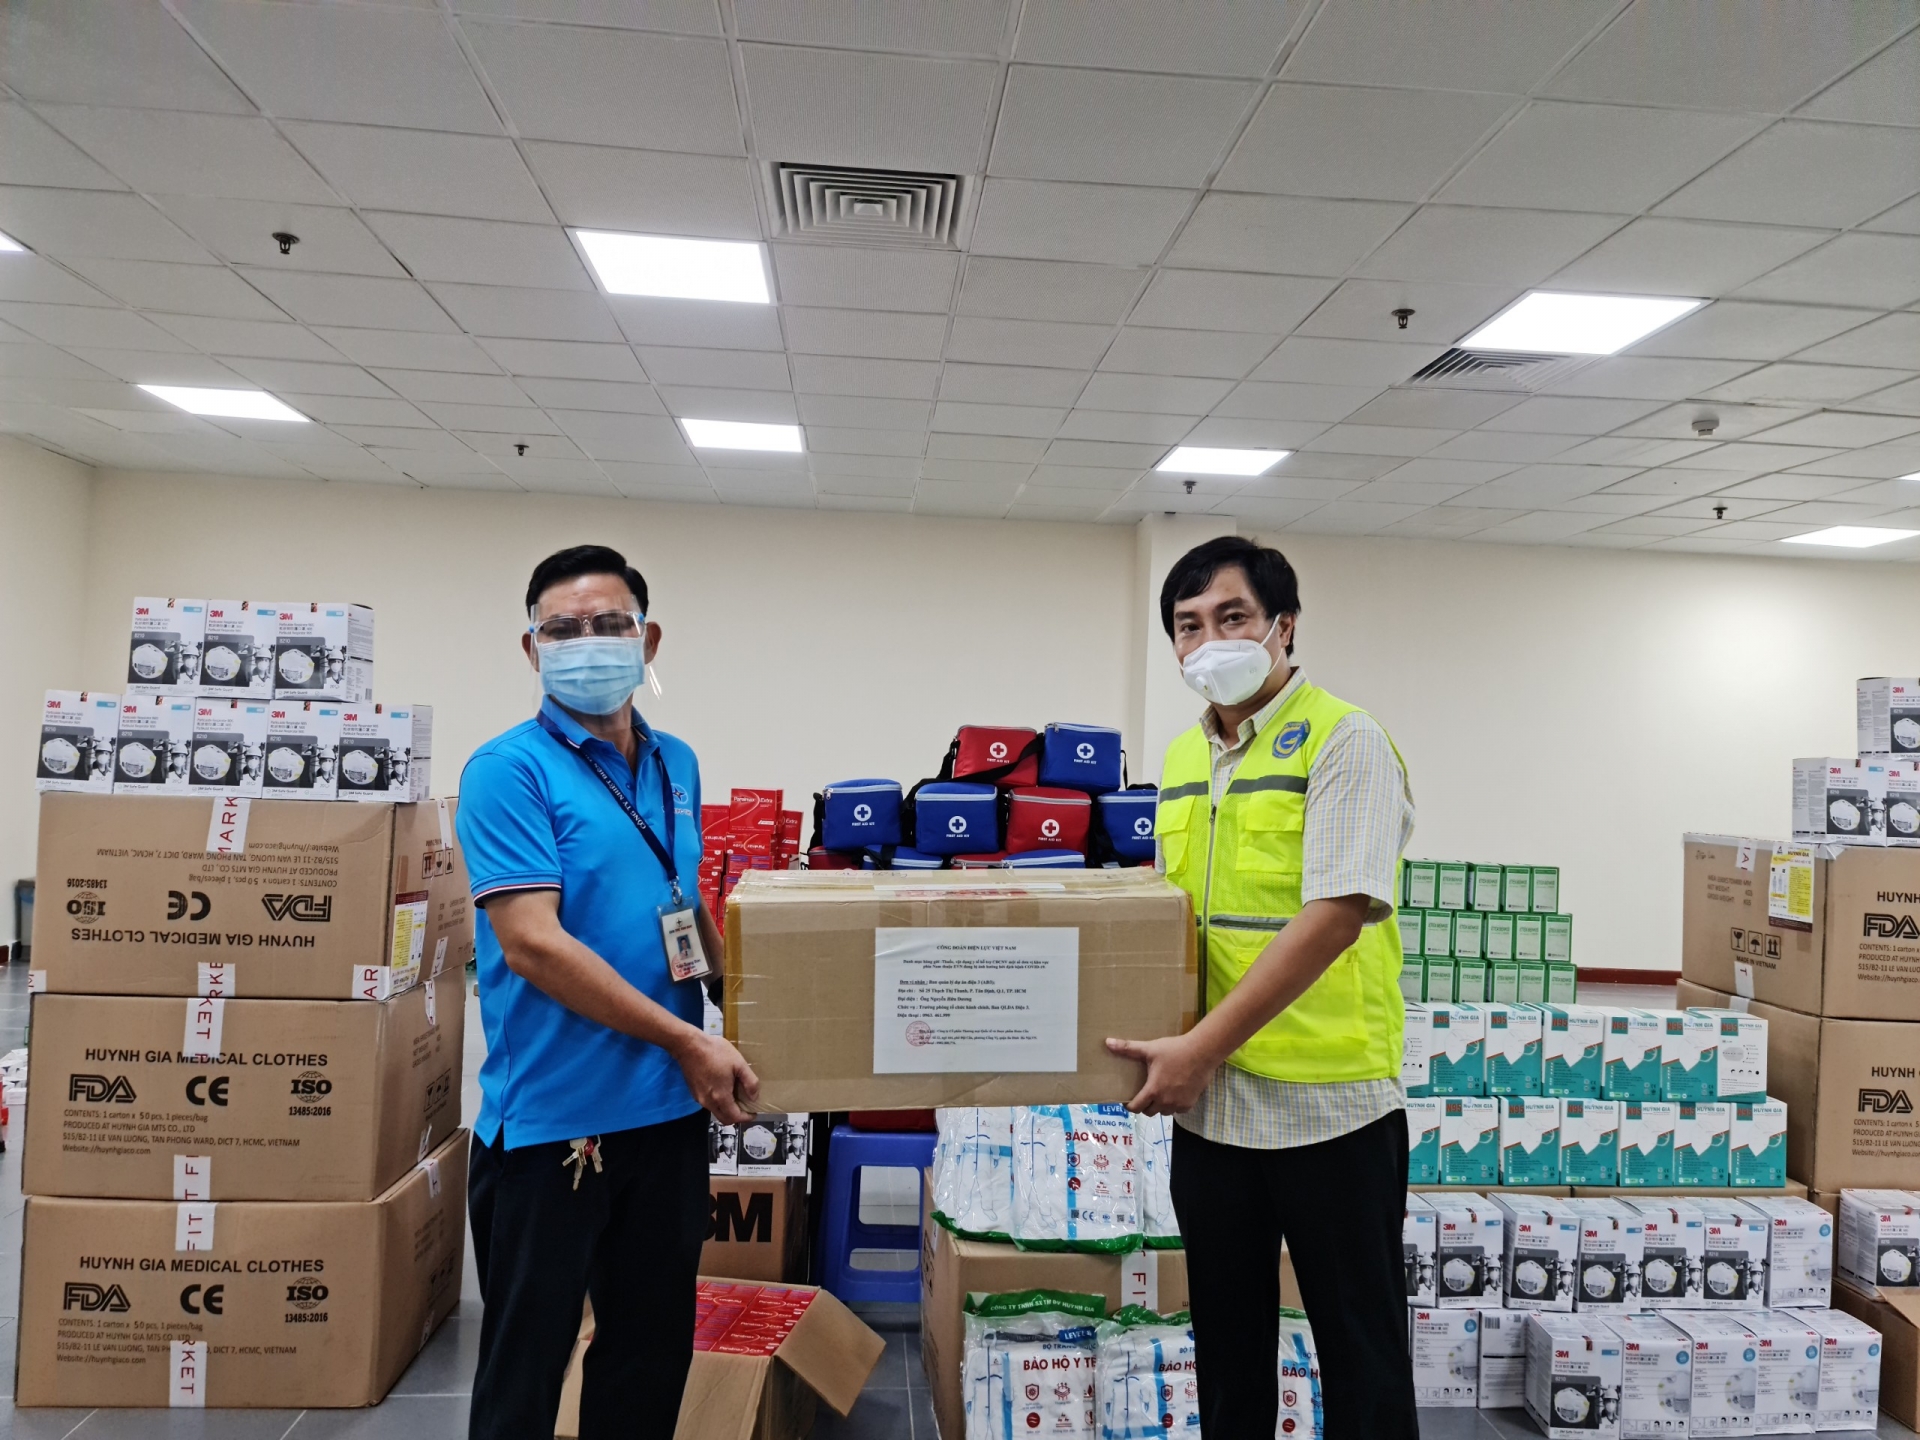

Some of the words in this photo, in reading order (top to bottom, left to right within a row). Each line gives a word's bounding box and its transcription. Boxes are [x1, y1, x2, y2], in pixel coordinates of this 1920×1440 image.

[47, 700, 61, 708] 3M
[123, 705, 137, 713] 3M
[198, 708, 212, 716] 3M
[271, 711, 285, 719] 3M
[343, 713, 358, 721] 3M
[1829, 767, 1841, 775] 3M
[202, 864, 214, 872] LTD
[230, 865, 246, 873] MTS
[247, 866, 261, 874] GIA
[262, 866, 288, 875] HUYNH
[289, 867, 299, 875] AT
[300, 868, 338, 876] PRODUCED
[67, 878, 108, 889] 13485:2016
[188, 874, 226, 884] pieces/bag
[270, 877, 291, 886] carton
[298, 878, 338, 888] CONTENTS:
[67, 899, 106, 916] ISO
[167, 890, 212, 921] CE
[261, 894, 332, 922] FDA
[1863, 913, 1920, 939] FDA
[71, 928, 145, 942] CLOTHES
[149, 931, 221, 945] MEDICAL
[226, 932, 253, 946] GIA
[259, 934, 315, 947] HUYNH
[1434, 1016, 1449, 1024] N95
[1492, 1016, 1507, 1024] N95
[1552, 1018, 1568, 1027] N95
[1667, 1022, 1683, 1031] N95
[85, 1048, 140, 1063] HUYNH
[145, 1050, 172, 1063] GIA
[177, 1052, 247, 1066] MEDICAL
[253, 1053, 328, 1066] CLOTHES
[1872, 1066, 1915, 1078] HUYNH
[69, 1074, 137, 1103] FDA
[186, 1076, 230, 1106] CE
[291, 1078, 332, 1097] ISO
[1858, 1088, 1913, 1113] FDA
[288, 1106, 331, 1116] 13485:2016
[1509, 1105, 1524, 1114] N95
[1627, 1107, 1642, 1115] N95
[171, 1113, 208, 1123] pieces/bag
[63, 1121, 100, 1130] PRODUCED
[101, 1122, 111, 1130] AT
[111, 1122, 136, 1131] HUYNH
[137, 1123, 150, 1131] GIA
[151, 1123, 166, 1132] MTS
[98, 1134, 107, 1142] LE
[108, 1134, 122, 1143] VAN
[123, 1135, 150, 1144] LUONG,
[151, 1135, 166, 1144] TAN
[166, 1136, 191, 1144] PHONG
[193, 1137, 216, 1146] WARD,
[217, 1137, 234, 1145] DICT
[243, 1138, 267, 1147] HCMC,
[268, 1138, 300, 1146] VIETNAM
[1111, 1135, 1119, 1144] Y
[1880, 1215, 1891, 1223] 3M
[1443, 1223, 1456, 1231] 3M
[1645, 1223, 1658, 1231] 3M
[1584, 1230, 1597, 1238] 3M
[80, 1256, 134, 1270] HUYNH
[140, 1258, 166, 1271] GIA
[170, 1259, 242, 1273] MEDICAL
[247, 1259, 324, 1273] CLOTHES
[63, 1282, 131, 1312] FDA
[286, 1285, 329, 1301] ISO
[180, 1284, 224, 1315] CE
[285, 1313, 328, 1323] 13485:2016
[1416, 1312, 1430, 1320] 3M
[1824, 1337, 1838, 1346] 3M
[1625, 1342, 1640, 1351] 3M
[1695, 1342, 1709, 1351] 3M
[1555, 1350, 1569, 1358] 3M
[1023, 1356, 1048, 1371] BẢO
[1052, 1355, 1070, 1371] HỘ
[1073, 1358, 1080, 1369] Y
[1158, 1360, 1181, 1372] BẢO
[1281, 1363, 1307, 1377] BẢO
